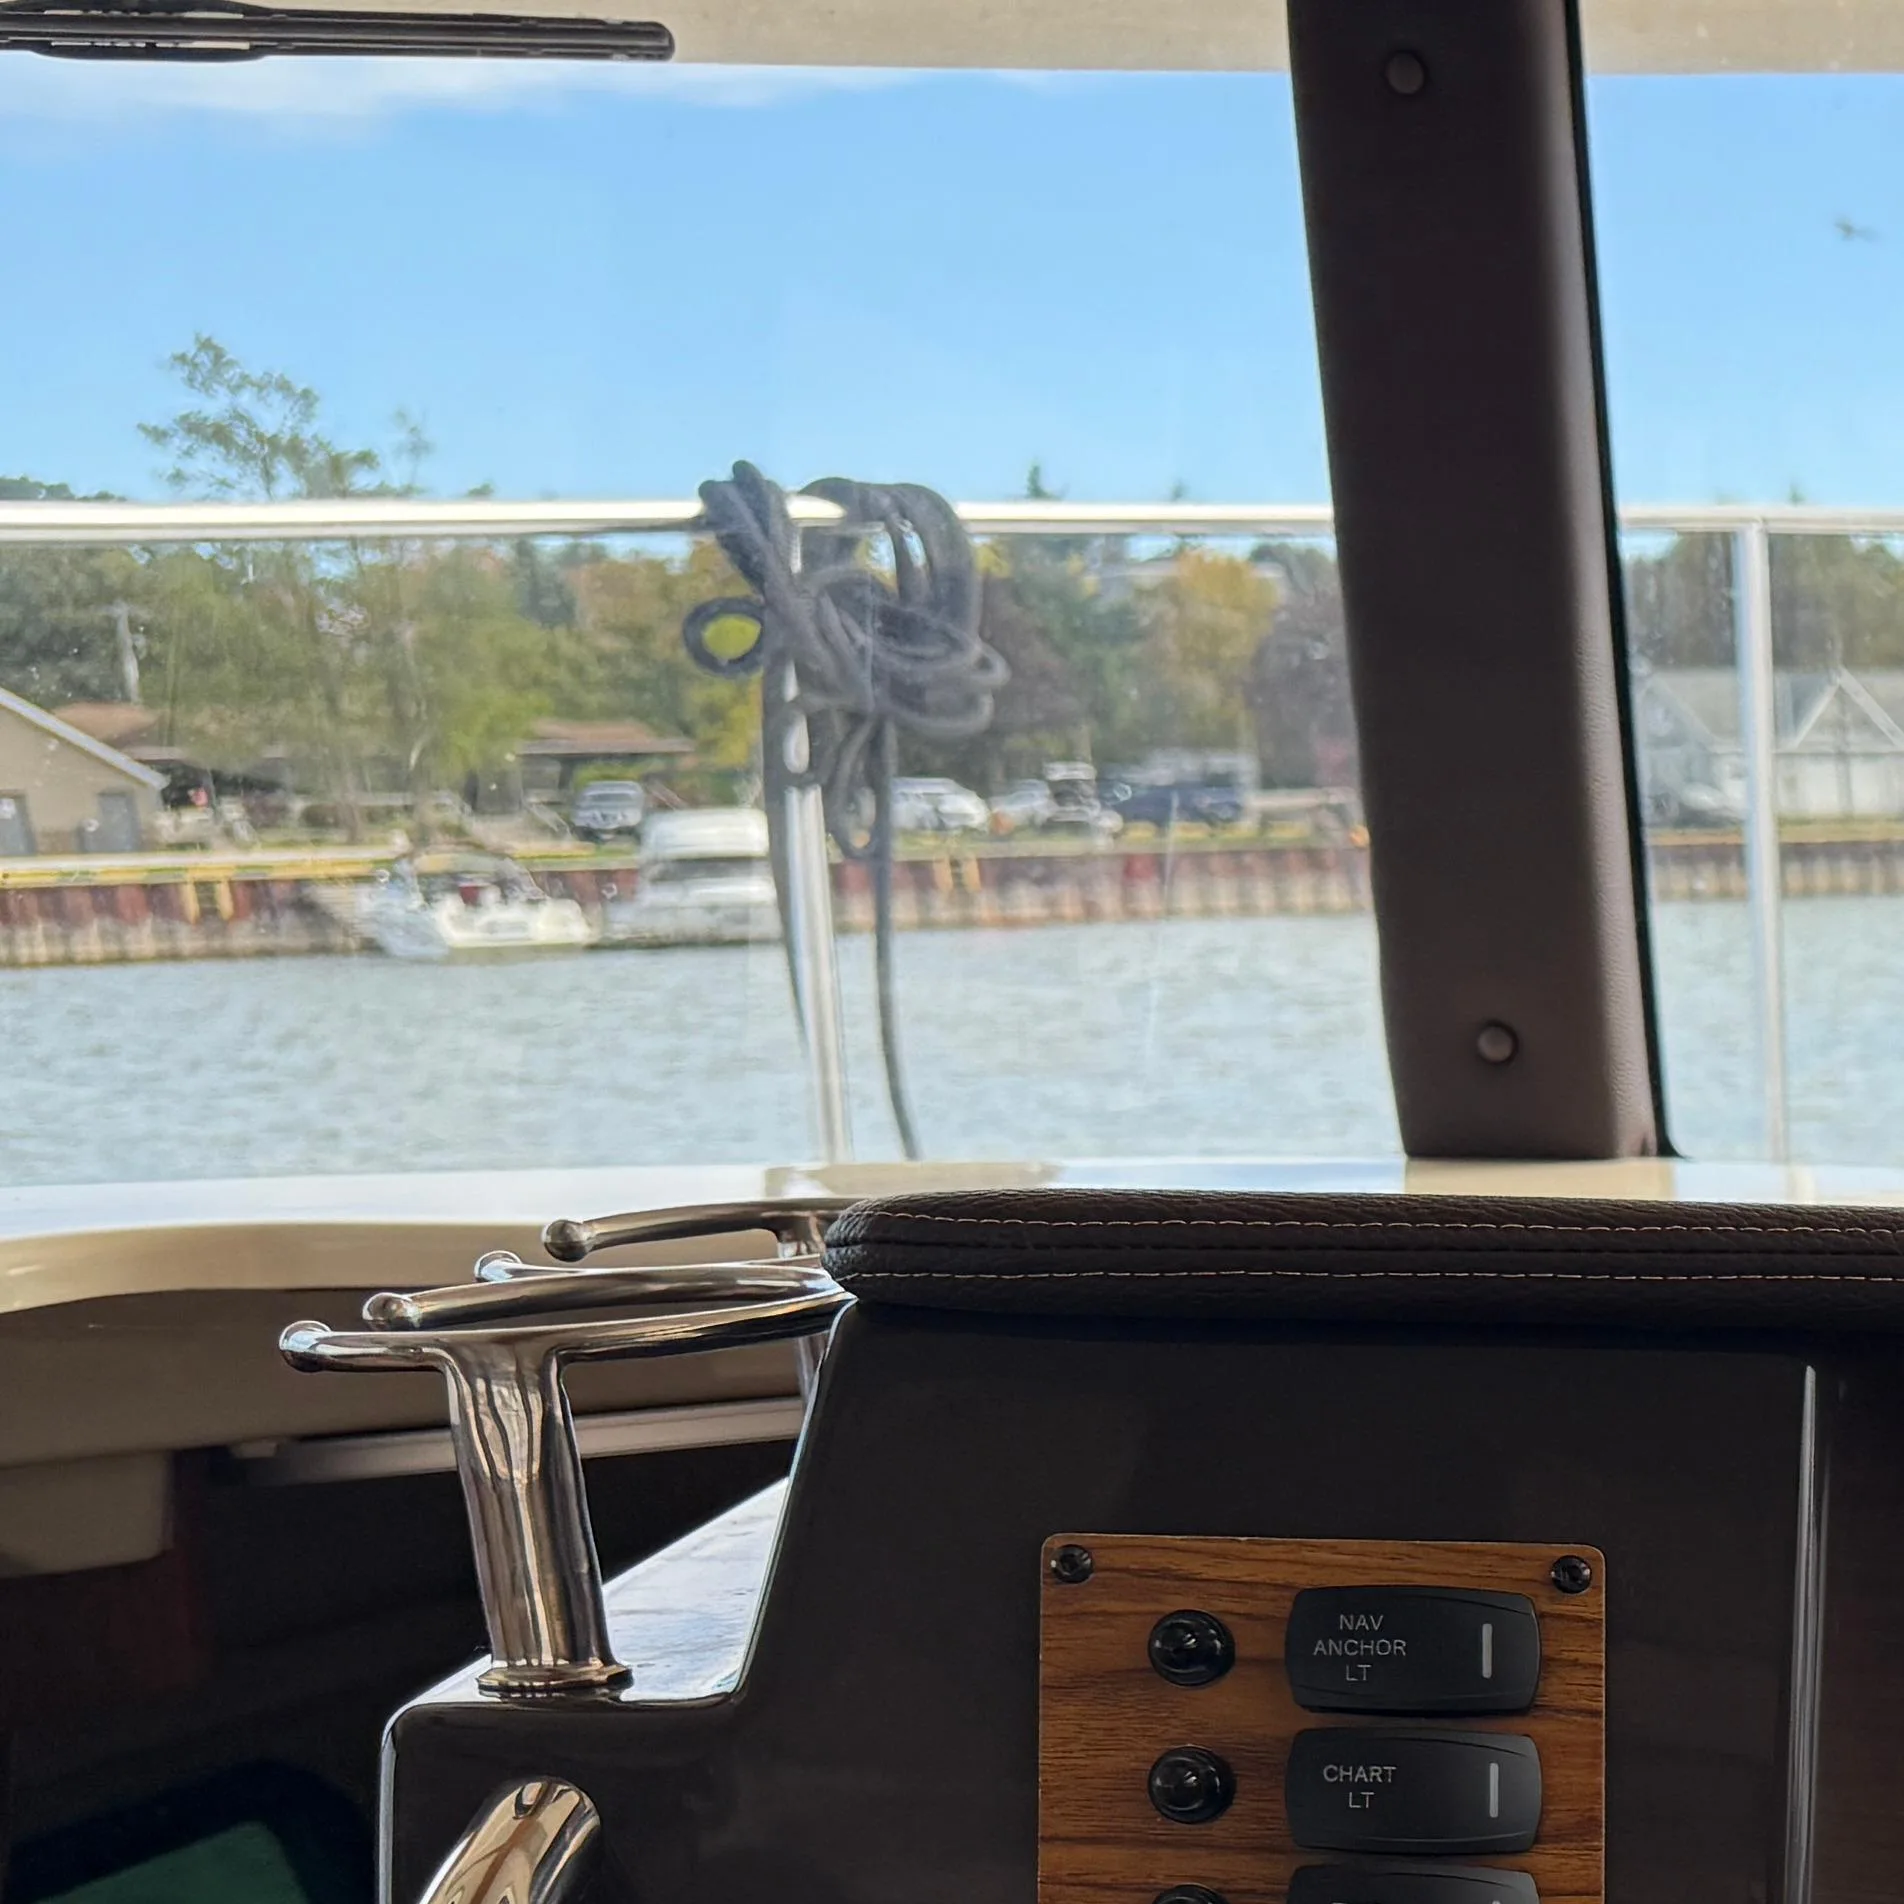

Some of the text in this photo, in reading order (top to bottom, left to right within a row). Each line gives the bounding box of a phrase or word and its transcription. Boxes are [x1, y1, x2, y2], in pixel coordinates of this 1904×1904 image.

[1339, 1614, 1384, 1631] NAV
[1313, 1639, 1407, 1657] ANCHOR
[1345, 1664, 1372, 1681] LT
[1323, 1765, 1397, 1783] CHART
[1349, 1792, 1374, 1809] LT
